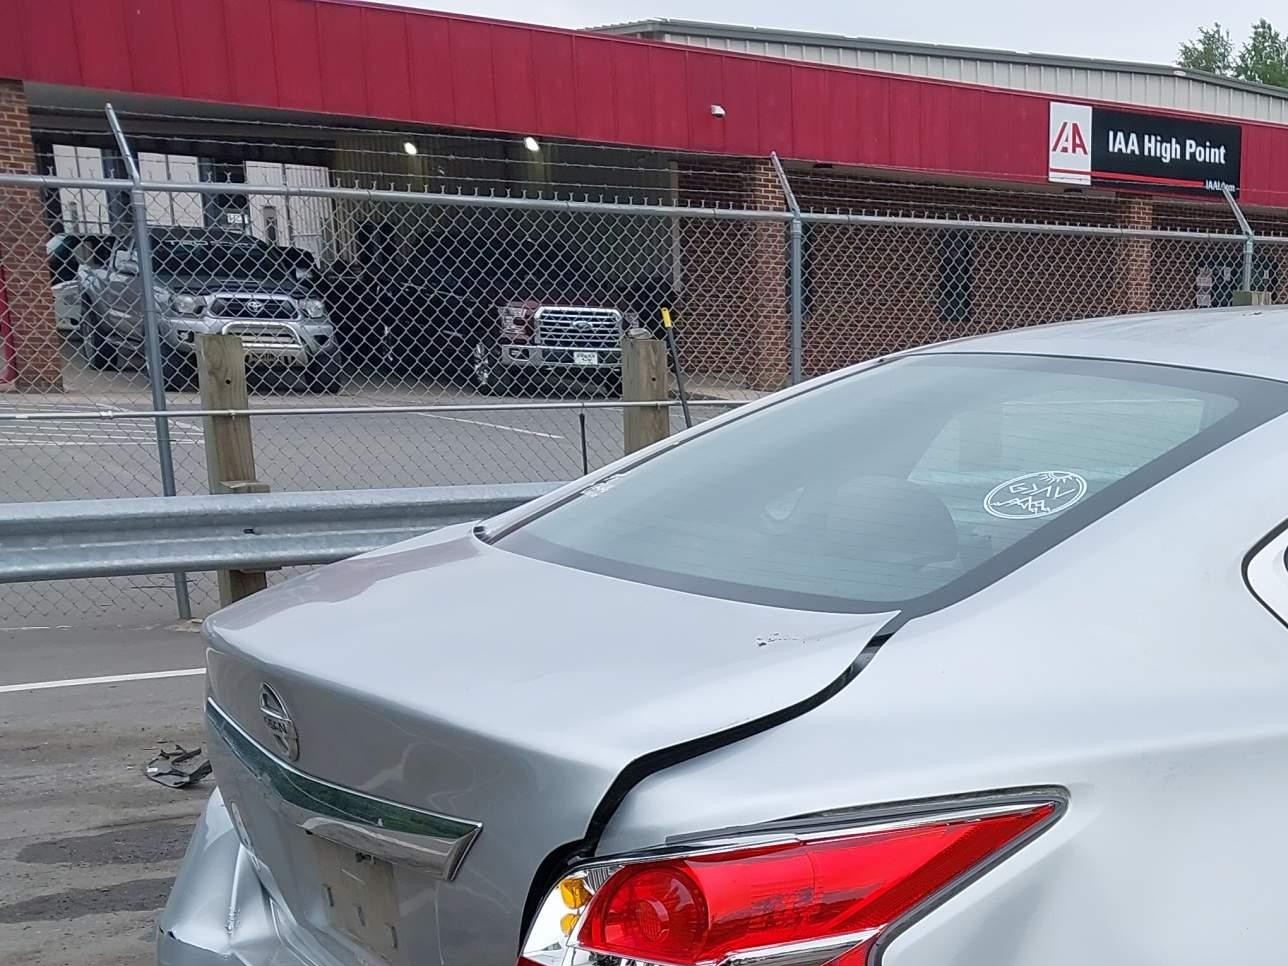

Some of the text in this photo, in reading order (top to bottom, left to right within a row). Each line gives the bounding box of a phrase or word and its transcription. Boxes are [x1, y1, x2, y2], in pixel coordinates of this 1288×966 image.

[1108, 130, 1226, 164] IAA High Point
